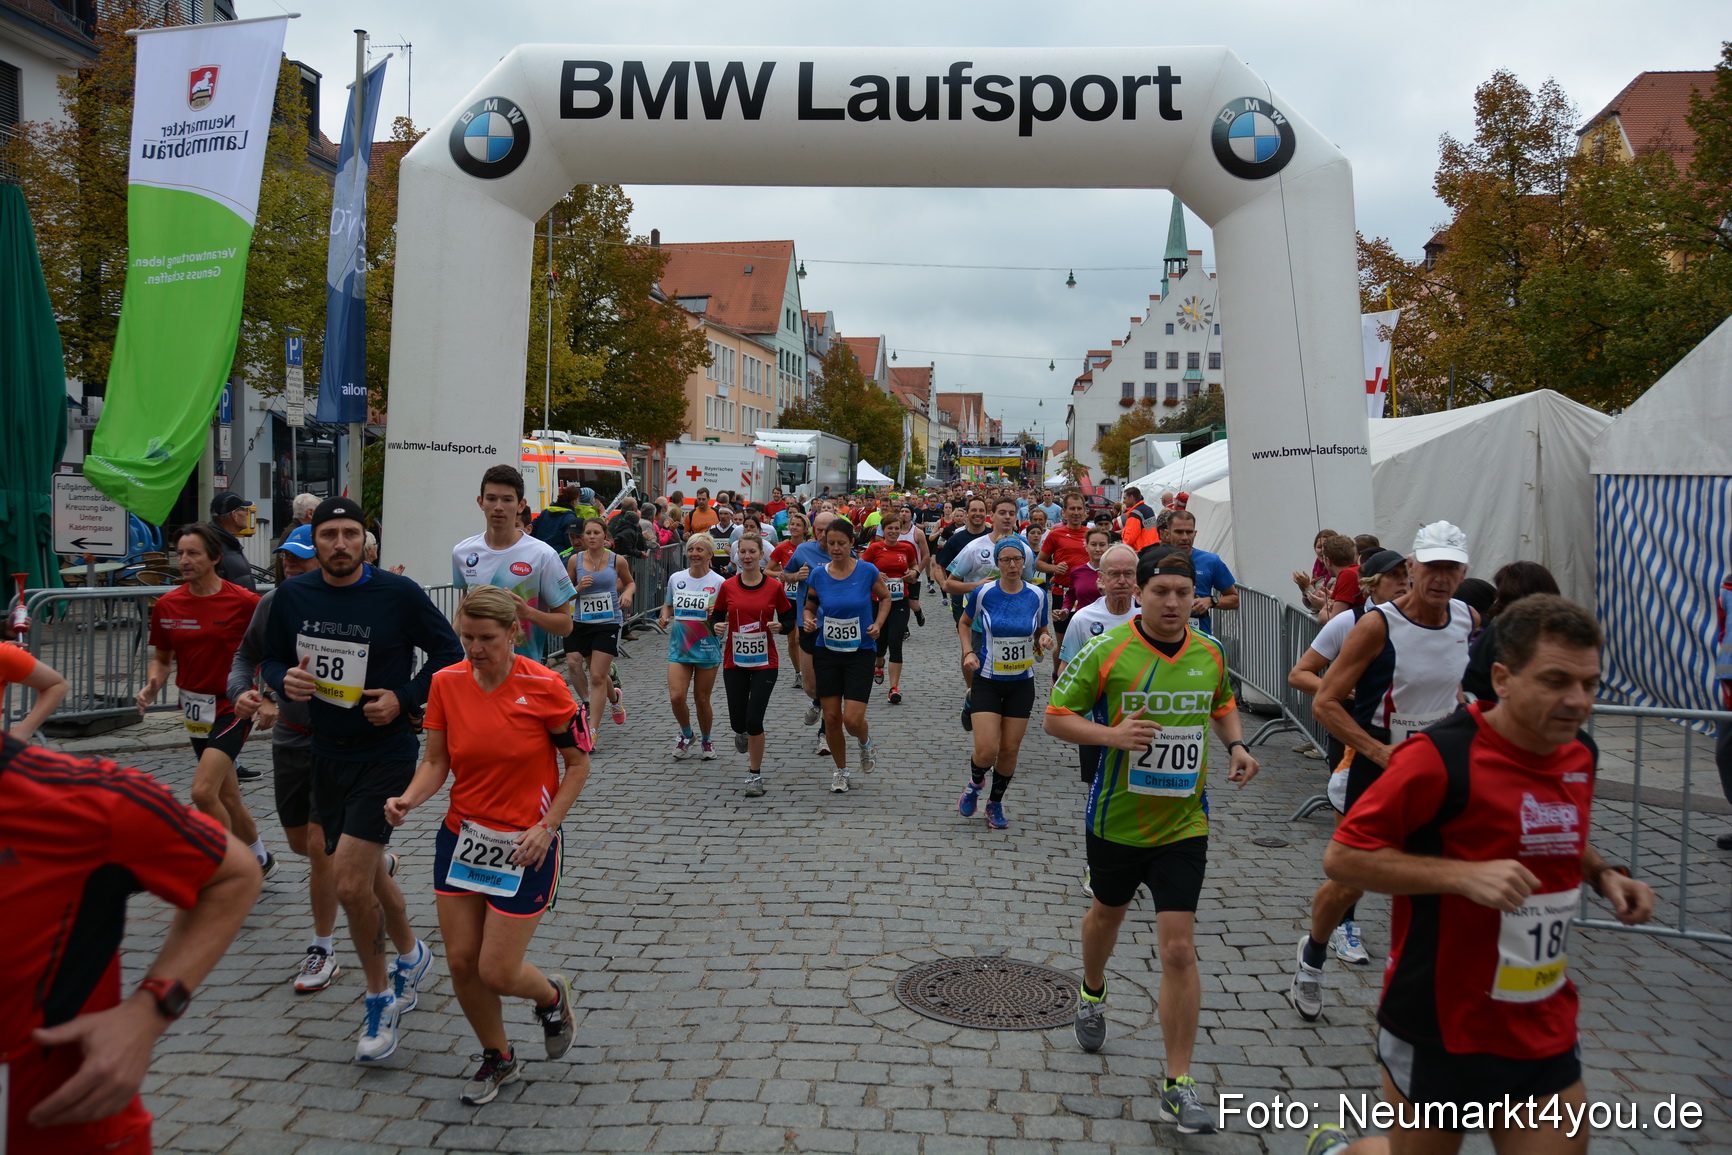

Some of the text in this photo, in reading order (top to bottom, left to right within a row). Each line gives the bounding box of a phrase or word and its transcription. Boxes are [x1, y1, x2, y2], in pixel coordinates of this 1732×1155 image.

[560, 60, 1183, 137] BMW Laufsport
[460, 98, 524, 125] BMW
[1219, 98, 1287, 125] BMW
[290, 337, 298, 360] P
[222, 388, 229, 418] P
[248, 438, 254, 450] 3
[388, 440, 497, 455] www.bmw-laufsport.de
[1252, 444, 1368, 460] www.bmw-laufsport.de
[57, 484, 94, 492] Fußgänger
[66, 503, 116, 512] Kreuzung über
[69, 524, 113, 533] Kaserngasse
[512, 564, 530, 573] Hervis
[584, 600, 610, 613] 2191
[677, 597, 705, 609] 2646
[320, 622, 371, 638] RUN
[827, 626, 858, 639] 2359
[298, 640, 355, 656] PARTL Neumarkt
[736, 640, 764, 654] 2555
[1002, 645, 1026, 661] 381
[316, 655, 344, 681] 58
[1122, 692, 1214, 714] BOCK
[184, 701, 200, 722] 20
[1392, 718, 1417, 726] PARTL
[1137, 743, 1198, 770] 2709
[1145, 774, 1189, 788] Christian
[461, 823, 514, 846] PARTL Neumarkt
[460, 837, 520, 871] 2224
[1528, 920, 1565, 961] 18
